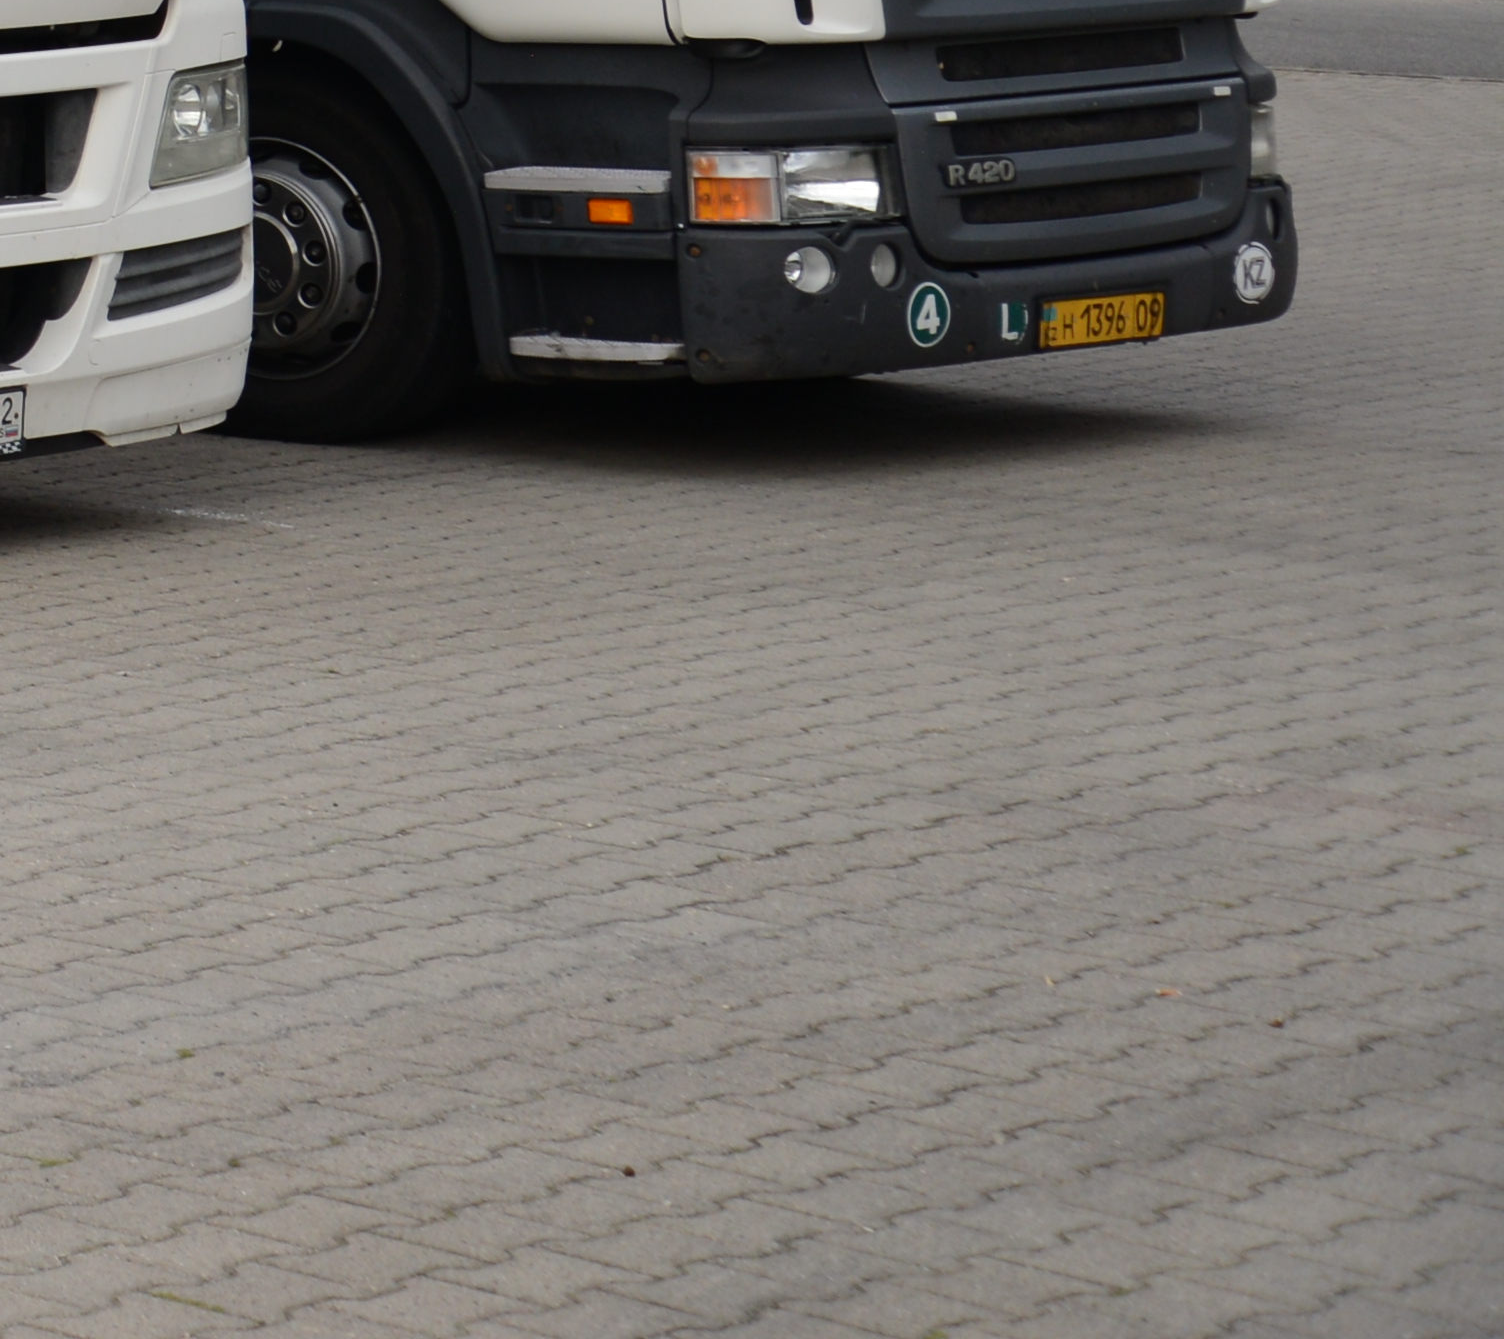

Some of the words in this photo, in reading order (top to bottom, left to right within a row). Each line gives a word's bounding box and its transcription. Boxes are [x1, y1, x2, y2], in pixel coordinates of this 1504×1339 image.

[948, 164, 966, 187] R
[968, 159, 1016, 184] 420
[1241, 256, 1267, 291] KZ
[916, 293, 941, 335] 4
